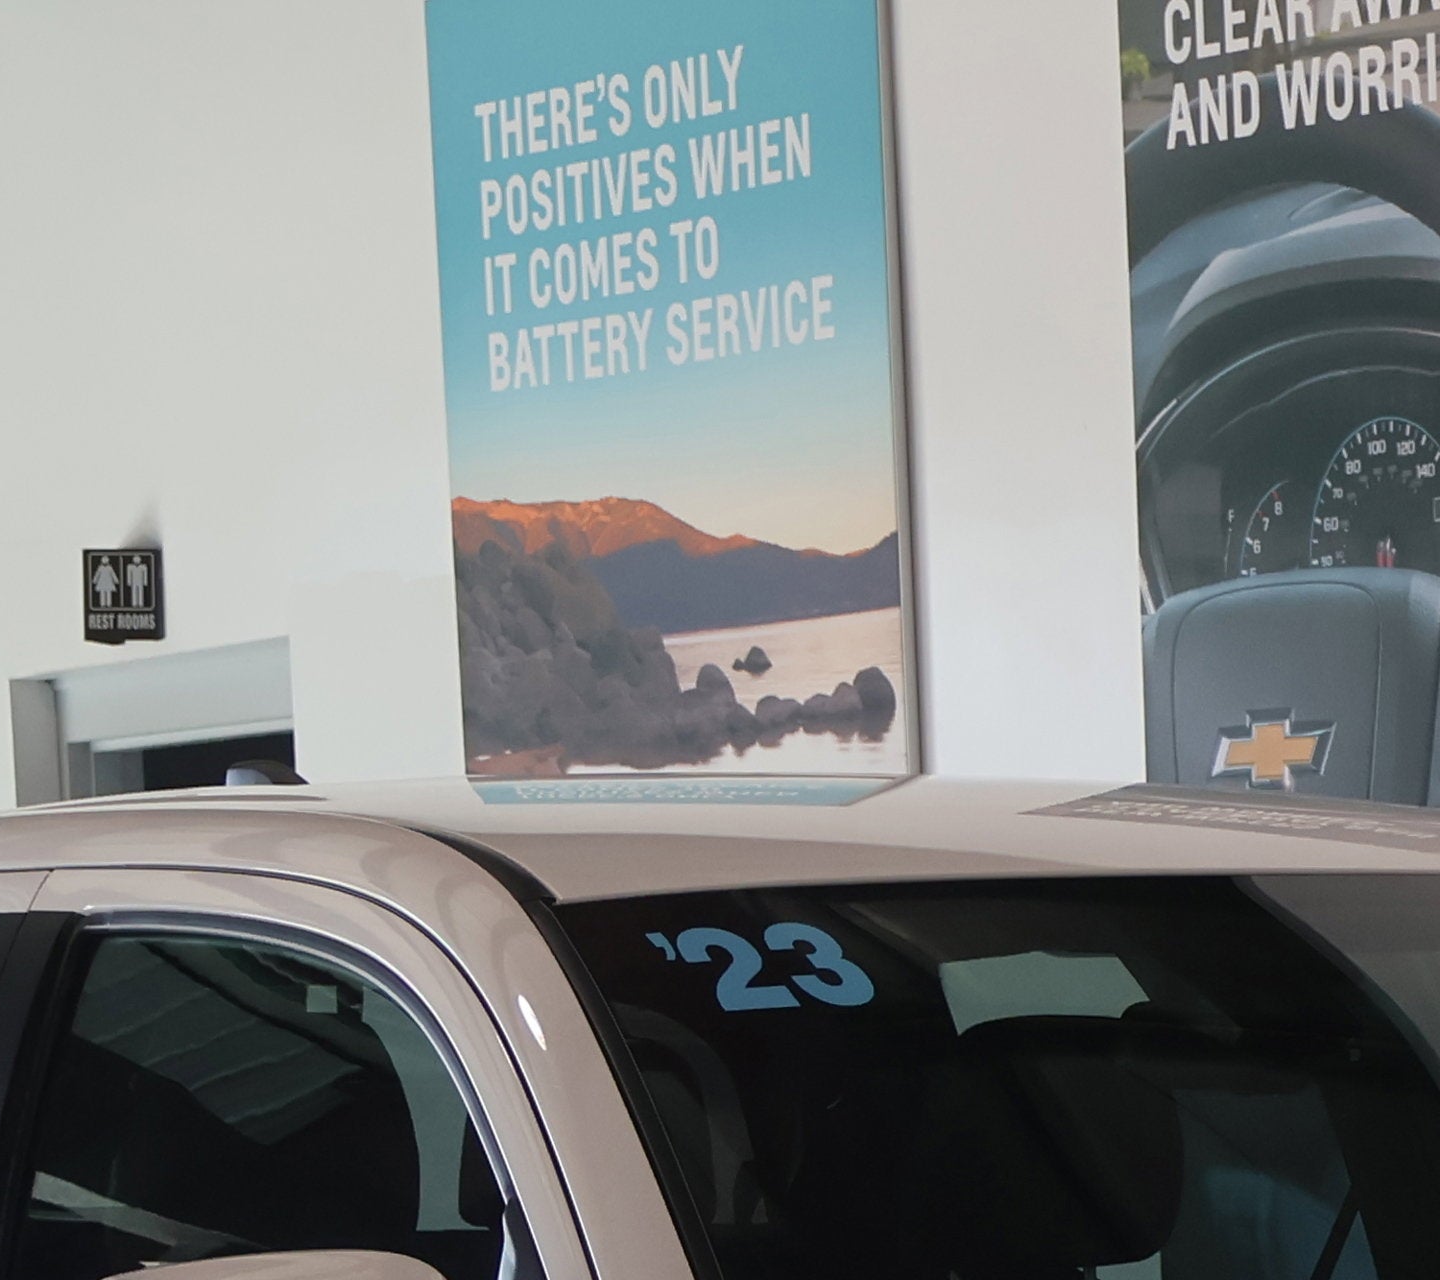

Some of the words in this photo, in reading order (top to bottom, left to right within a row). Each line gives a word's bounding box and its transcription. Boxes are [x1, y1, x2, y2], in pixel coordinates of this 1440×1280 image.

[1164, 0, 1315, 64] CLEAR
[474, 73, 632, 162] THERE'S
[644, 45, 744, 129] ONLY
[1166, 69, 1260, 150] AND
[480, 143, 677, 240] POSITIVES
[689, 113, 812, 199] WHEN
[484, 253, 516, 316] IT
[529, 227, 659, 309] COMES
[670, 215, 720, 284] TO
[488, 308, 654, 392] BATTERY
[666, 274, 836, 366] SERVICE
[1367, 439, 1387, 455] 100
[1396, 440, 1416, 456] 120
[1345, 459, 1361, 475] 80
[1416, 463, 1436, 479] 140
[1274, 501, 1283, 516] 8
[1262, 516, 1270, 532] 7
[1323, 517, 1339, 532] 60
[1253, 539, 1261, 554] 6
[88, 613, 115, 630] REST
[116, 613, 156, 630] ROOMS
[645, 922, 875, 1012] '23
